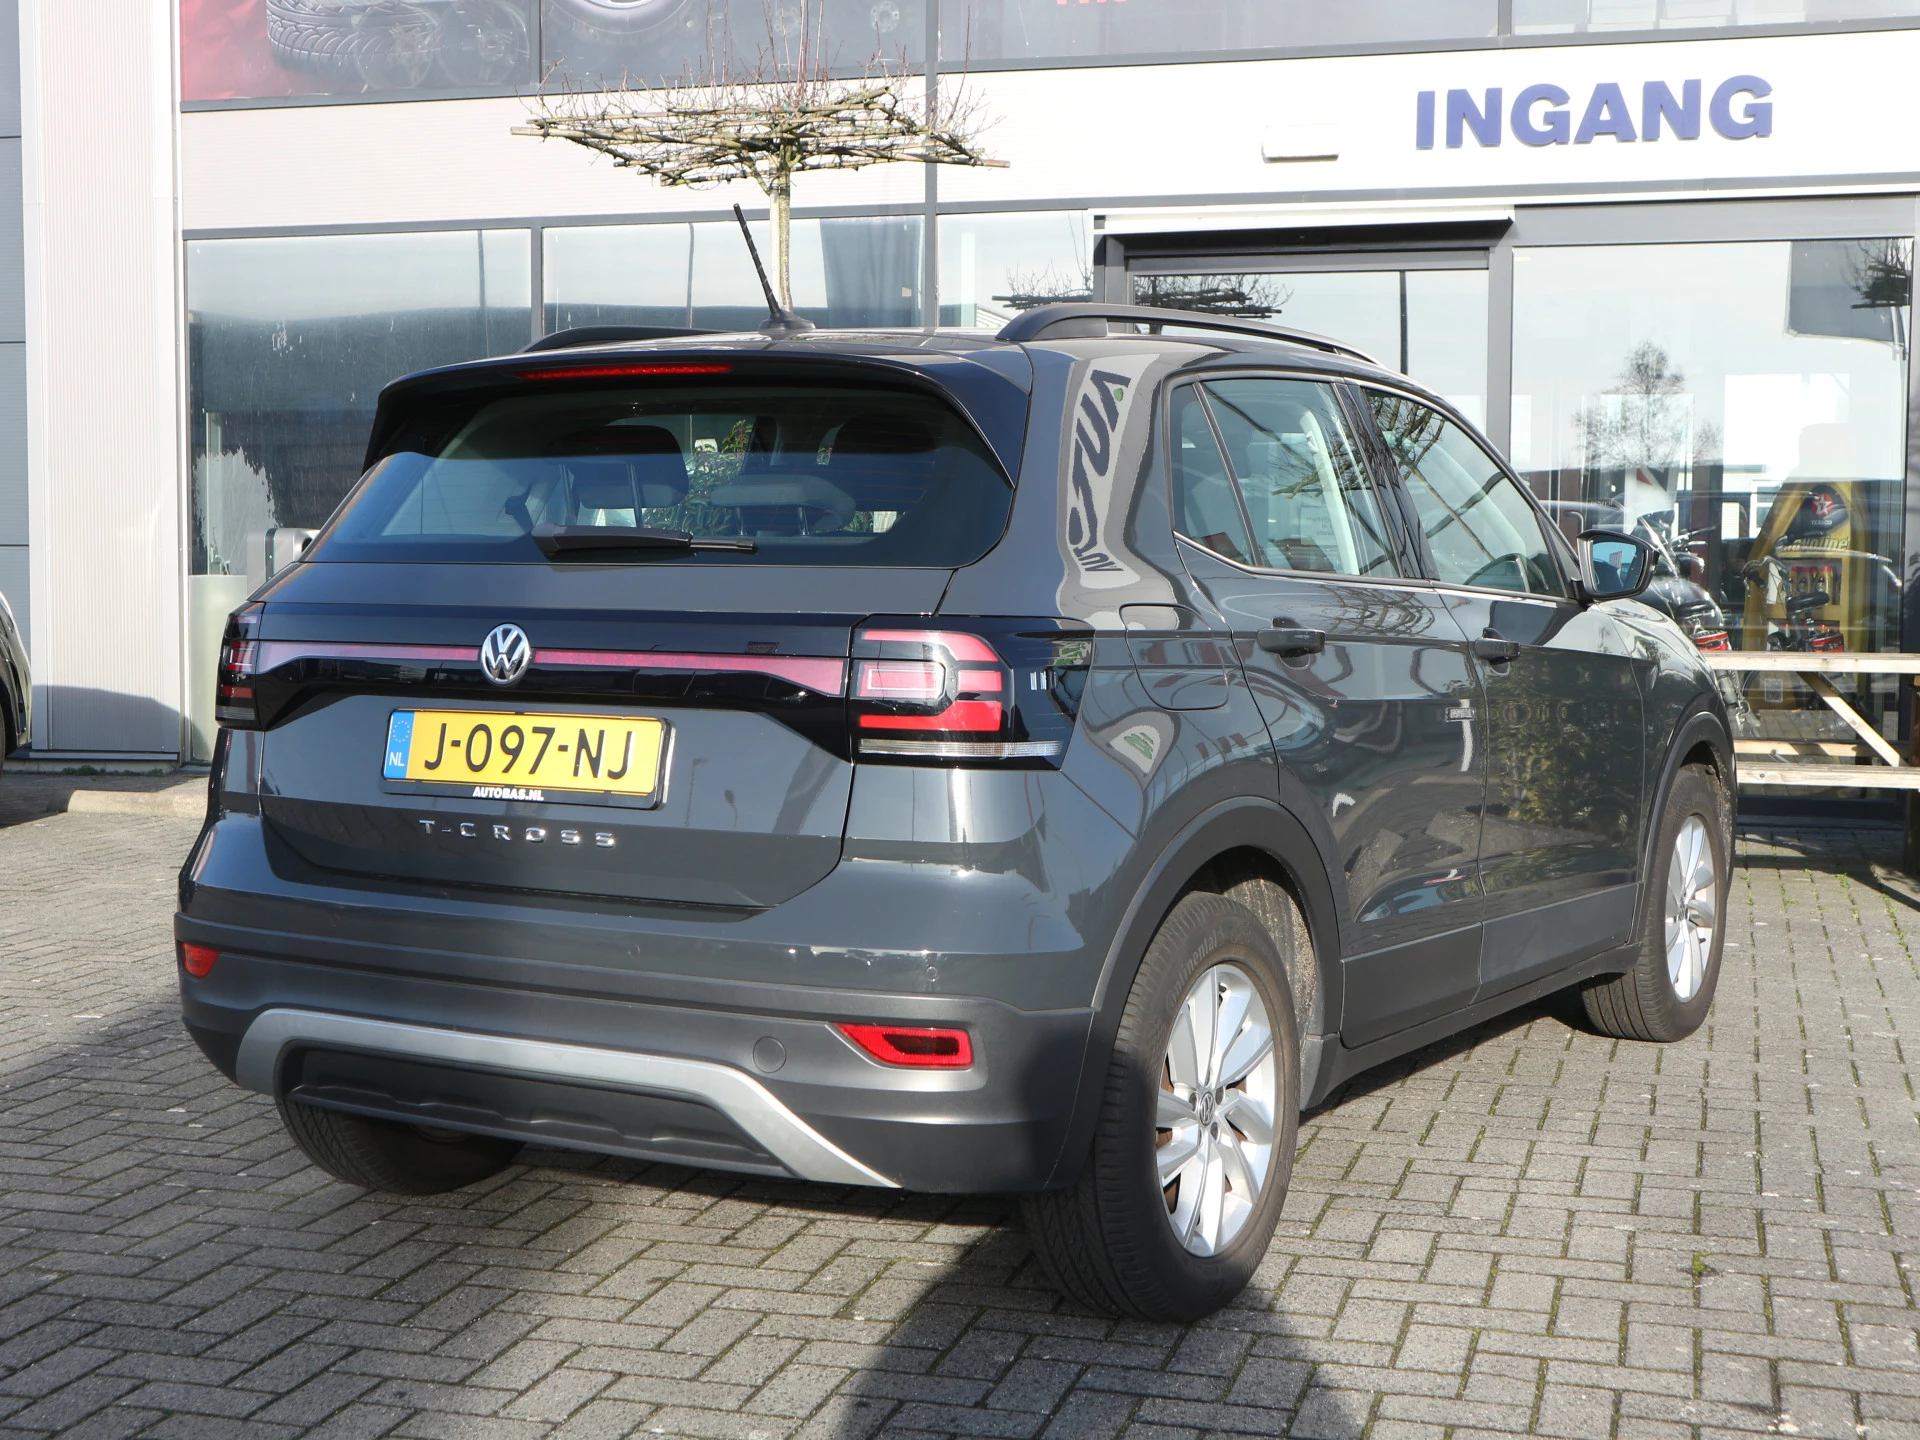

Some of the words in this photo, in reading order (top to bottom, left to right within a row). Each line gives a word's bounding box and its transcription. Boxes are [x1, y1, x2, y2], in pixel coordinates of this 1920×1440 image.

[1416, 75, 1773, 150] INGANG
[388, 751, 405, 768] NL
[424, 723, 634, 780] J-097-NJ
[472, 786, 545, 802] AUTOBAS.NL
[418, 819, 617, 848] T-CROSS
